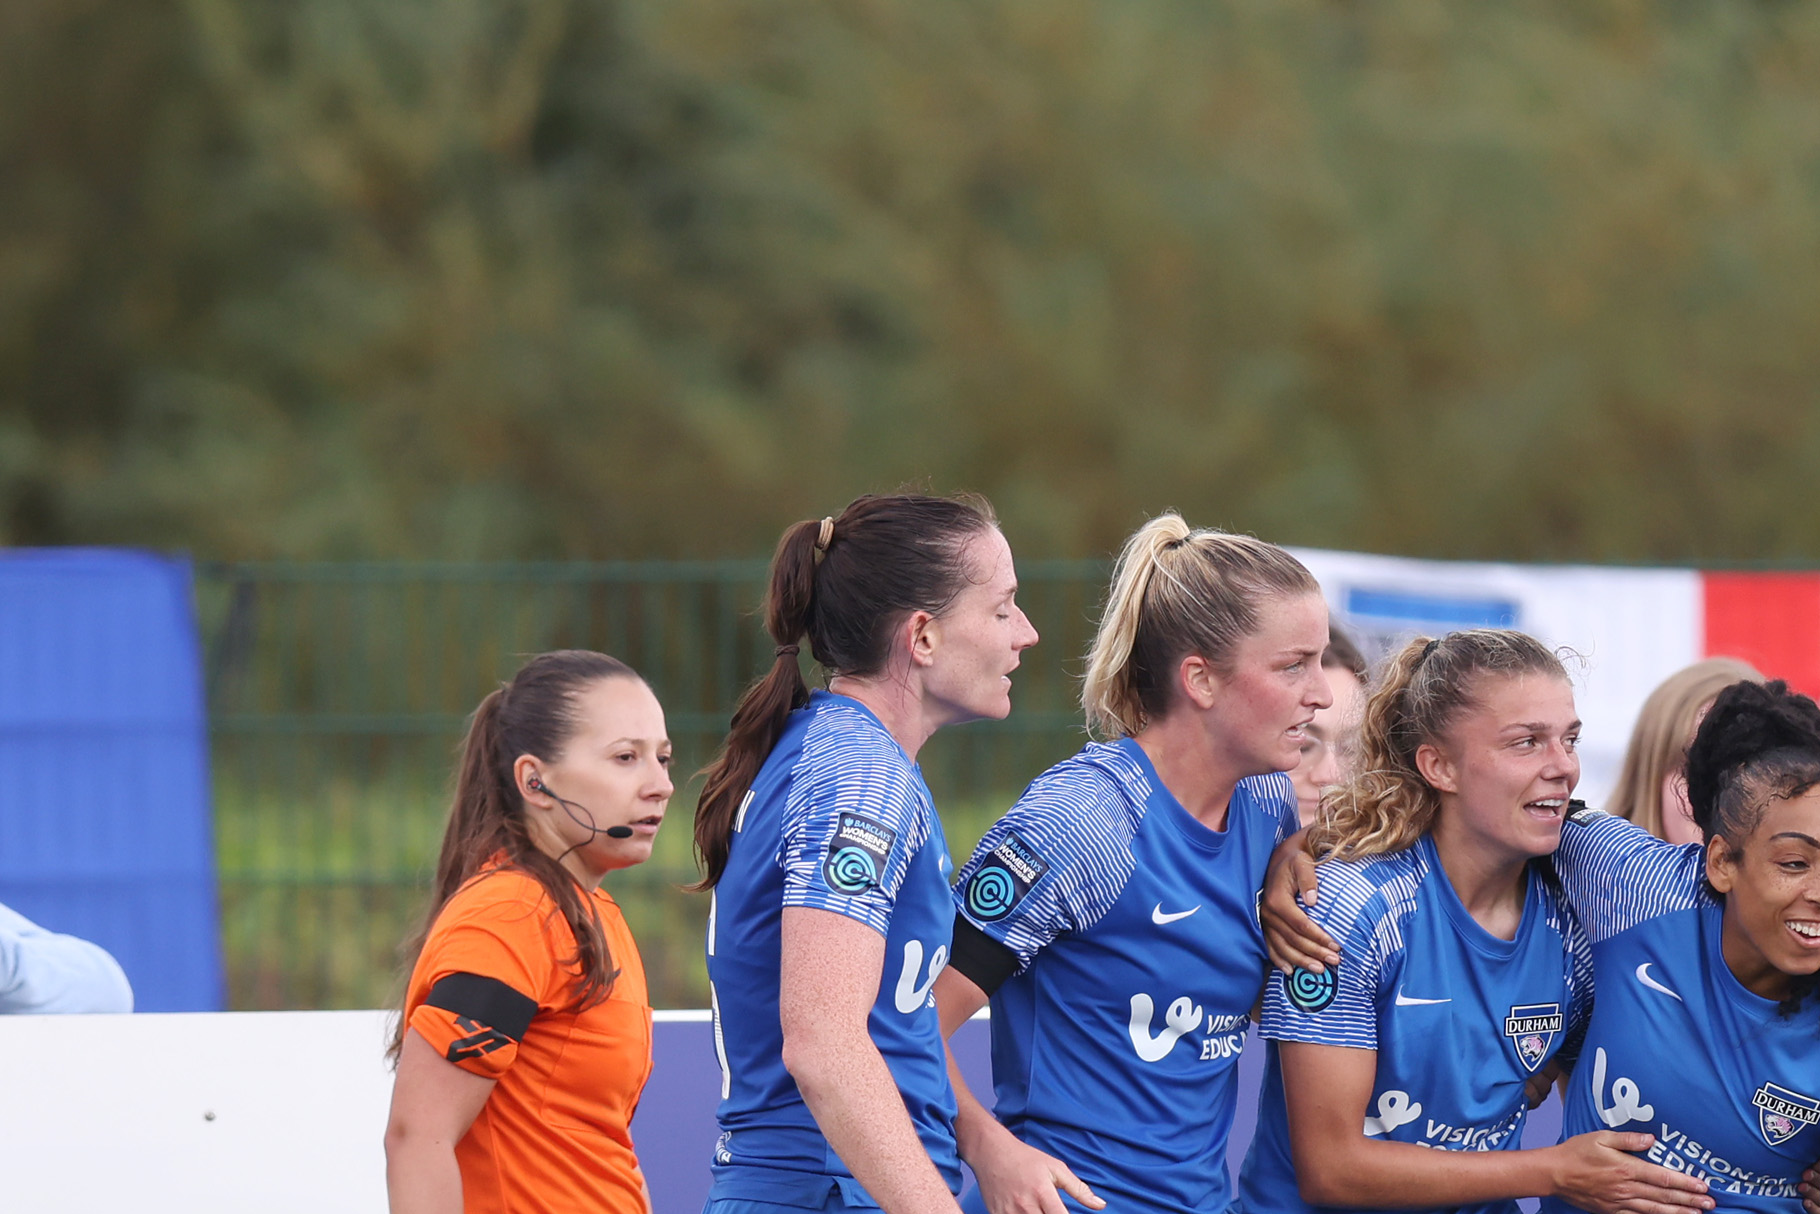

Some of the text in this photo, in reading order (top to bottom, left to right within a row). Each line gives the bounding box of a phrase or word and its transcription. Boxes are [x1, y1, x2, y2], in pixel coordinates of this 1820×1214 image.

[839, 833, 886, 855] CHAMPIONSHIP
[842, 826, 889, 851] WOMEN'S
[854, 819, 891, 842] BARCLAYS
[994, 849, 1031, 884] CHAMPIONSHIP
[999, 843, 1037, 880] WOMEN'S
[1011, 842, 1043, 873] BARCLAYS
[1508, 1017, 1560, 1034] DURHAM
[1756, 1092, 1819, 1123] DURHAM
[1661, 1122, 1753, 1181] VISION
